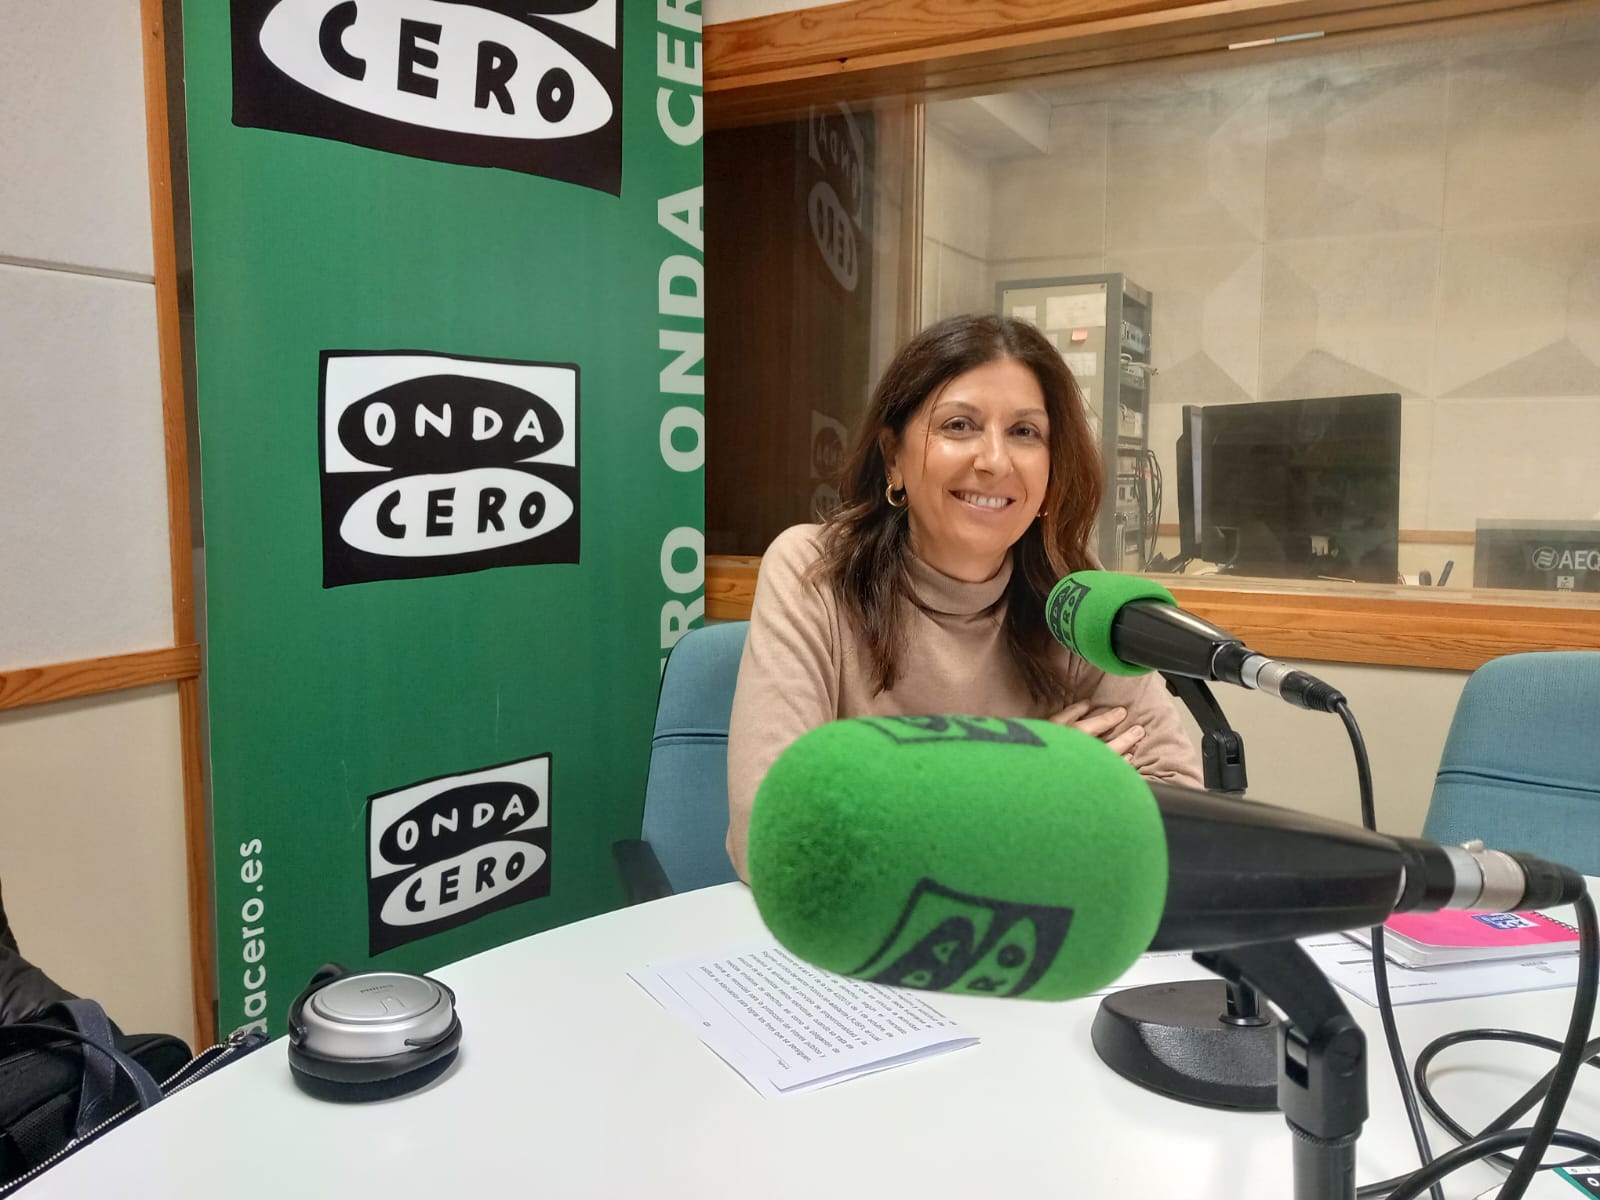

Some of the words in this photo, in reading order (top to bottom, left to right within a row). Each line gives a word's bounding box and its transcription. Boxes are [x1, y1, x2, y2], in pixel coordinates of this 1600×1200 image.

[319, 0, 575, 123] CERO
[658, 185, 704, 472] ONDA
[363, 402, 545, 446] ONDA
[376, 486, 546, 539] CERO
[661, 526, 704, 678] RO
[396, 794, 526, 852] ONDA
[404, 851, 526, 912] CERO
